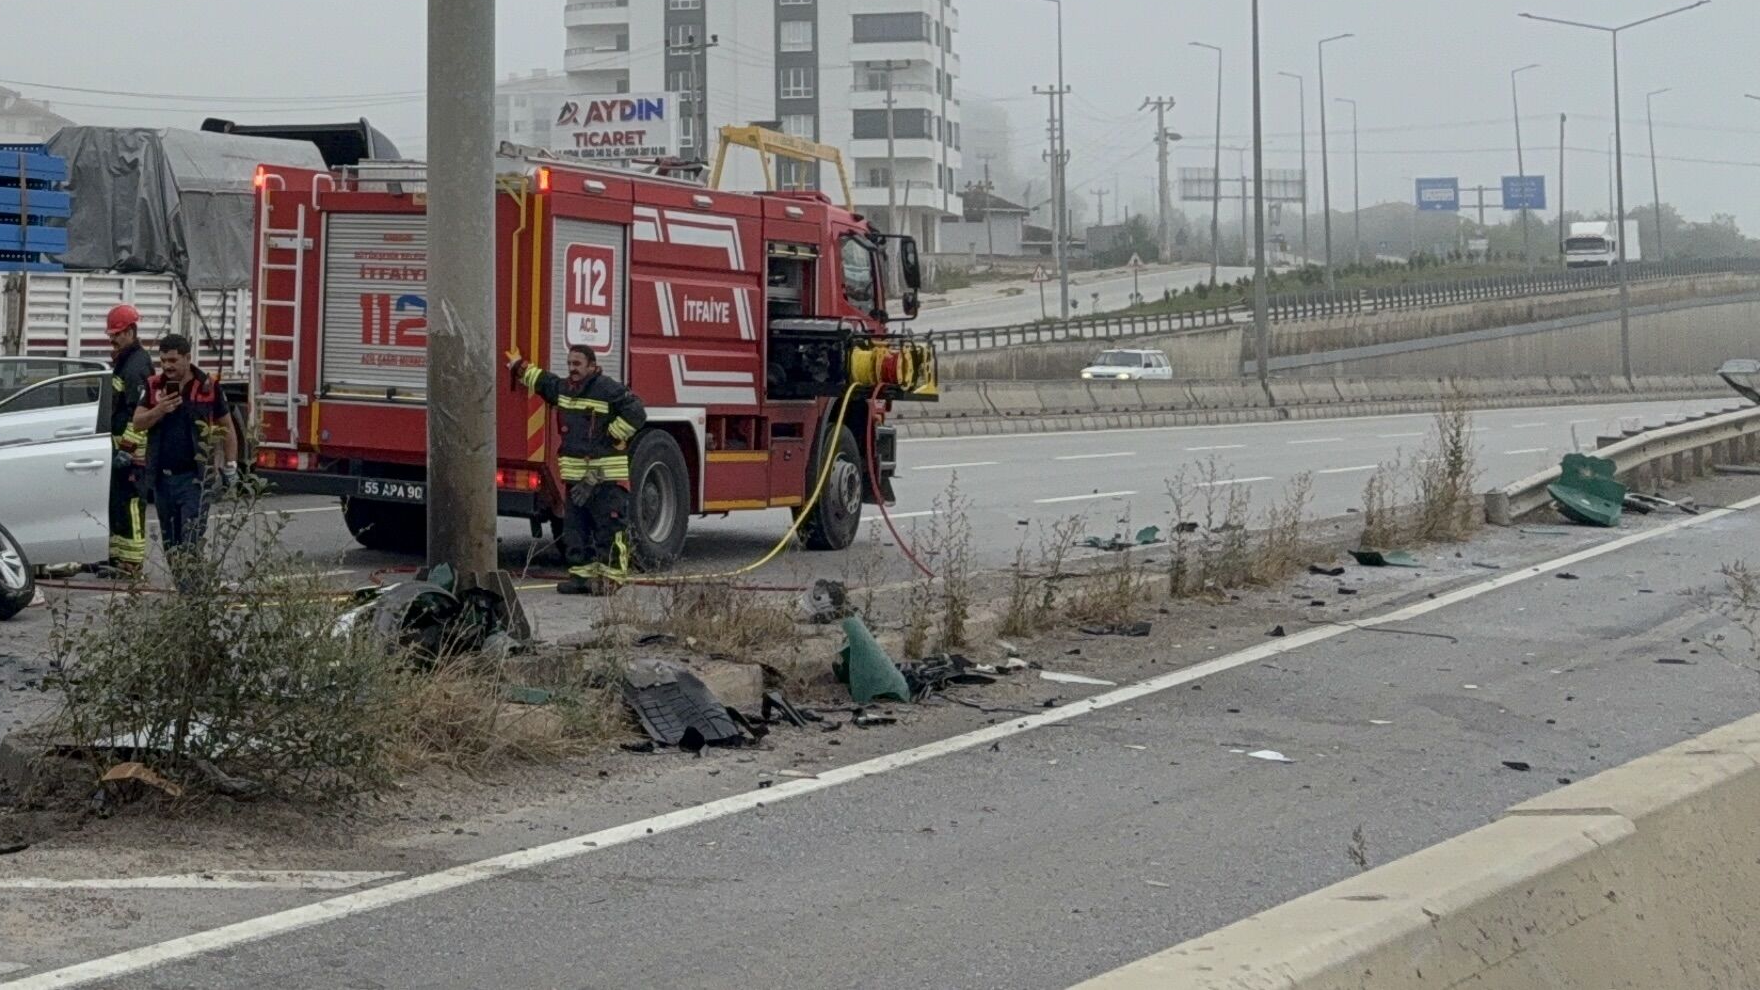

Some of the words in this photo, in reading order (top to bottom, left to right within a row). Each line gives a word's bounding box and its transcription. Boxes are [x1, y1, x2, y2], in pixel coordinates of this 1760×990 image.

[583, 97, 664, 127] AYDIN
[572, 256, 607, 307] 112
[683, 294, 730, 323] İTFAİYE
[364, 481, 379, 495] 55
